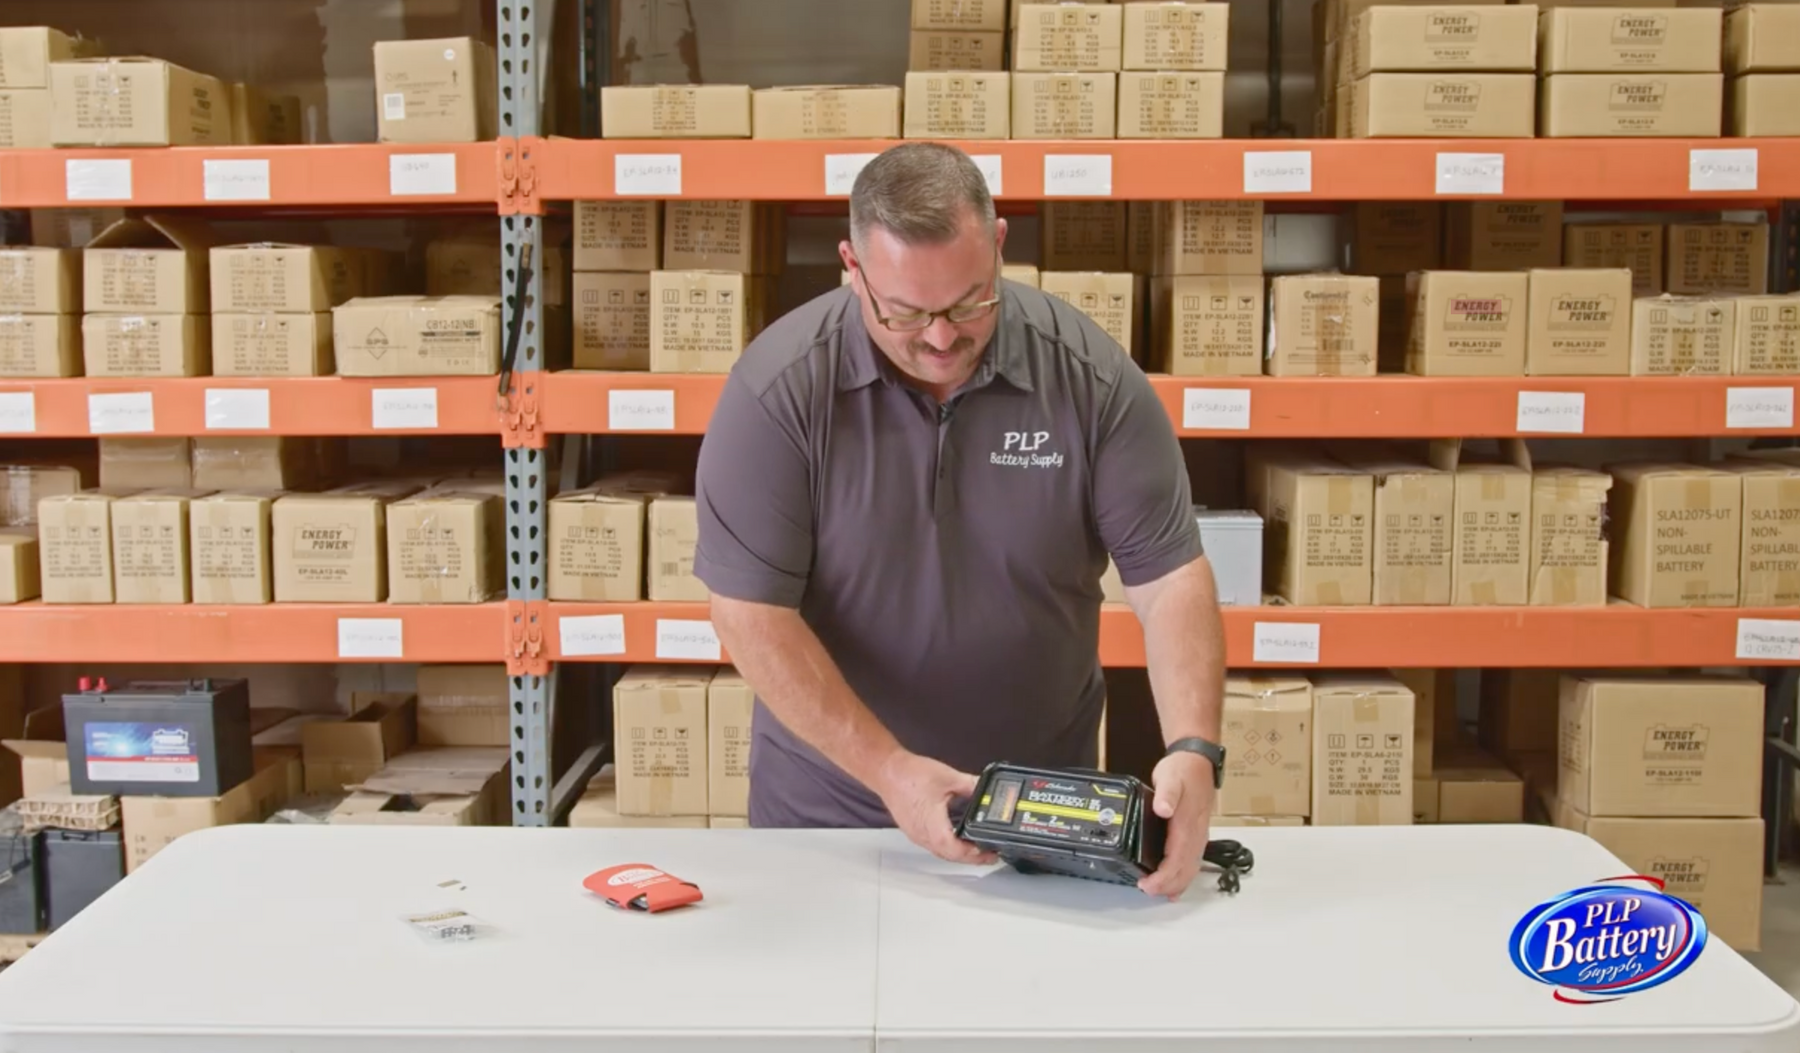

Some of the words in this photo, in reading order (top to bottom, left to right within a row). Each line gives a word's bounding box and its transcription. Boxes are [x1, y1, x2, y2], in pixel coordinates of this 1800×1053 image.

[1433, 17, 1468, 25] ENERGY
[1620, 19, 1656, 28] ENERGY
[1433, 86, 1468, 94] ENERGY
[1617, 86, 1653, 94] ENERGY
[1454, 301, 1498, 311] ENERGY
[1558, 300, 1601, 311] ENERGY
[1464, 311, 1502, 321] POWER
[1568, 311, 1606, 321] POWER
[1004, 431, 1050, 451] PLP
[990, 452, 1029, 468] Battery
[1030, 452, 1063, 468] Supply
[1657, 508, 1732, 521] SLA12075-UT
[1751, 509, 1800, 521] SLA1207
[302, 530, 343, 540] ENERGY
[1657, 527, 1688, 538] NON-
[1751, 527, 1782, 537] NON-
[312, 540, 348, 550] POWER
[1656, 543, 1713, 556] SPILLABLE
[1656, 561, 1705, 573] BATTERY
[1750, 560, 1799, 572] BATTERY
[1653, 730, 1695, 740] ENERGY
[1663, 741, 1701, 751] POWER
[1652, 862, 1695, 872] ENERGY
[1663, 873, 1701, 883] POWER
